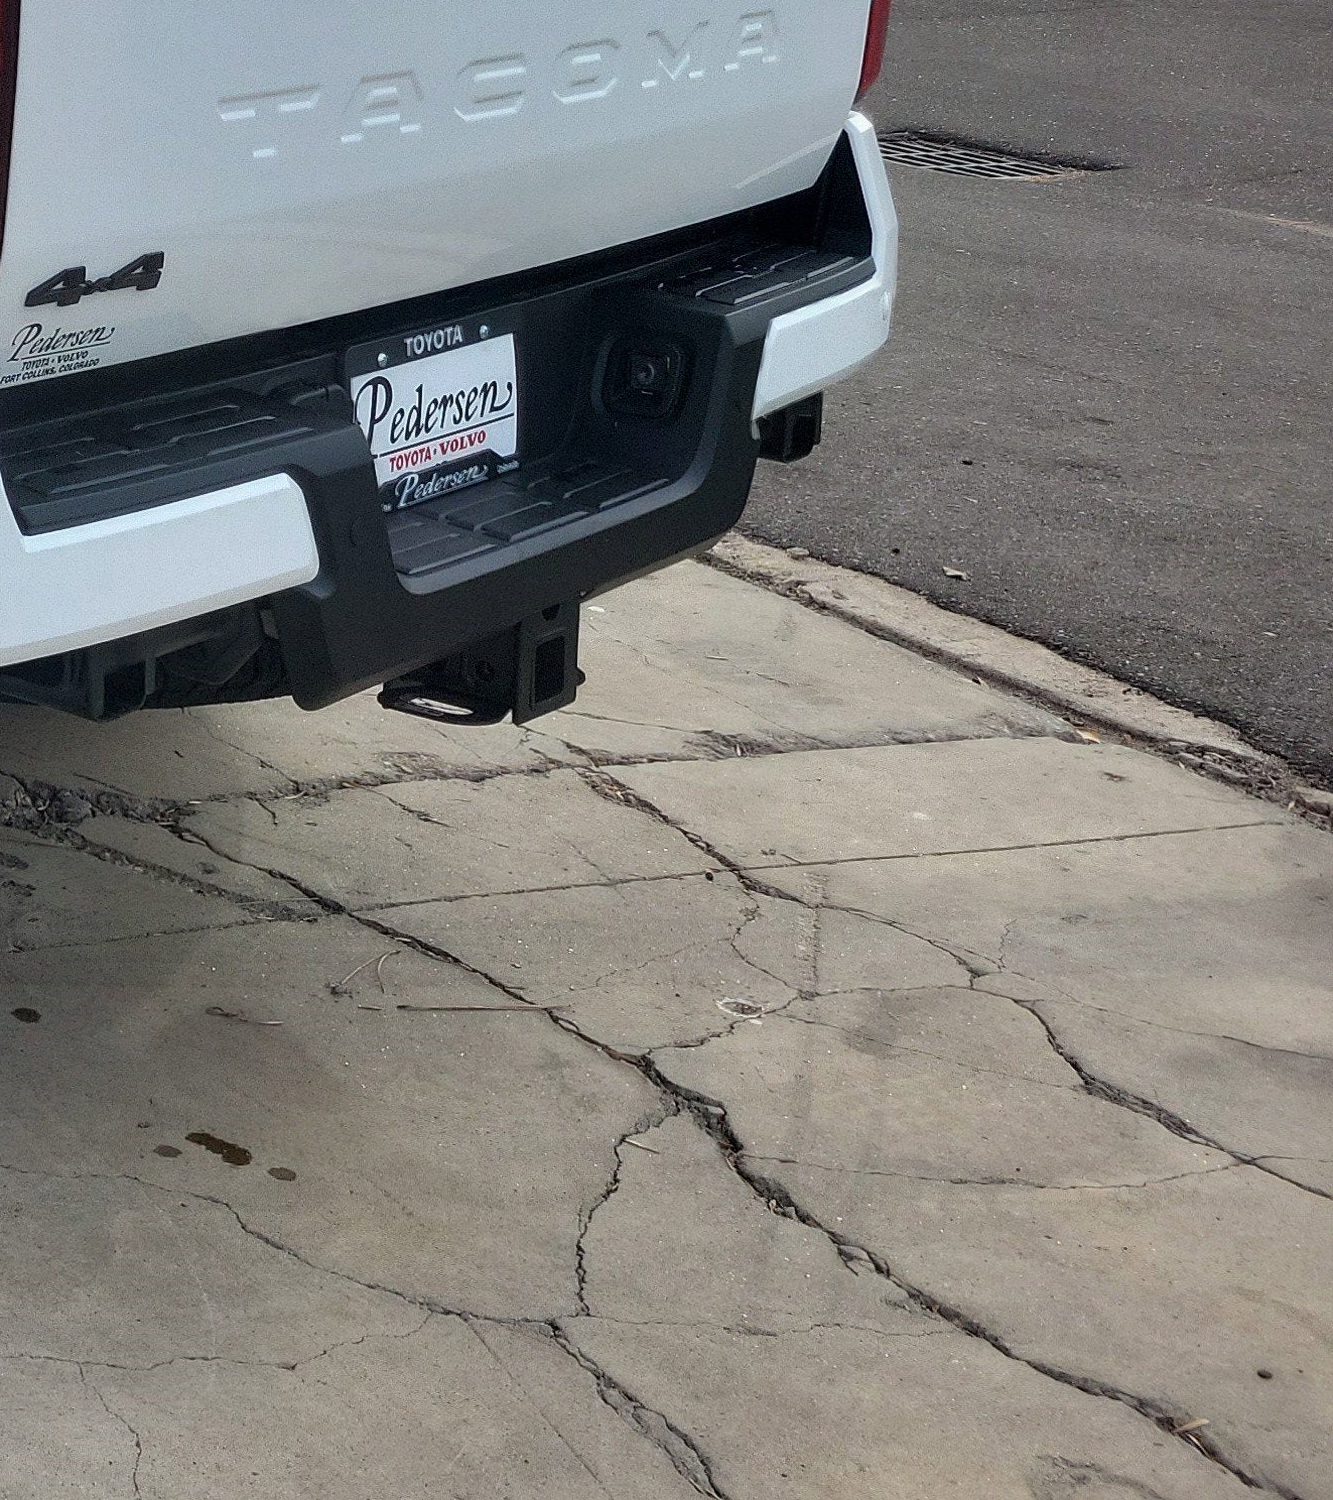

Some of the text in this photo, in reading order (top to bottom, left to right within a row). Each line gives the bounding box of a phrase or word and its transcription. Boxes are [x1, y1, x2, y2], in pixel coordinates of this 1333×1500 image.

[217, 8, 779, 160] TACOMA
[6, 322, 115, 363] Pedersen
[57, 350, 89, 364] VOLVO
[403, 324, 464, 357] TOYOTA
[355, 375, 513, 456] Pedersen
[389, 429, 487, 472] TOYOTA VOLVO
[394, 464, 489, 508] Pedersen
